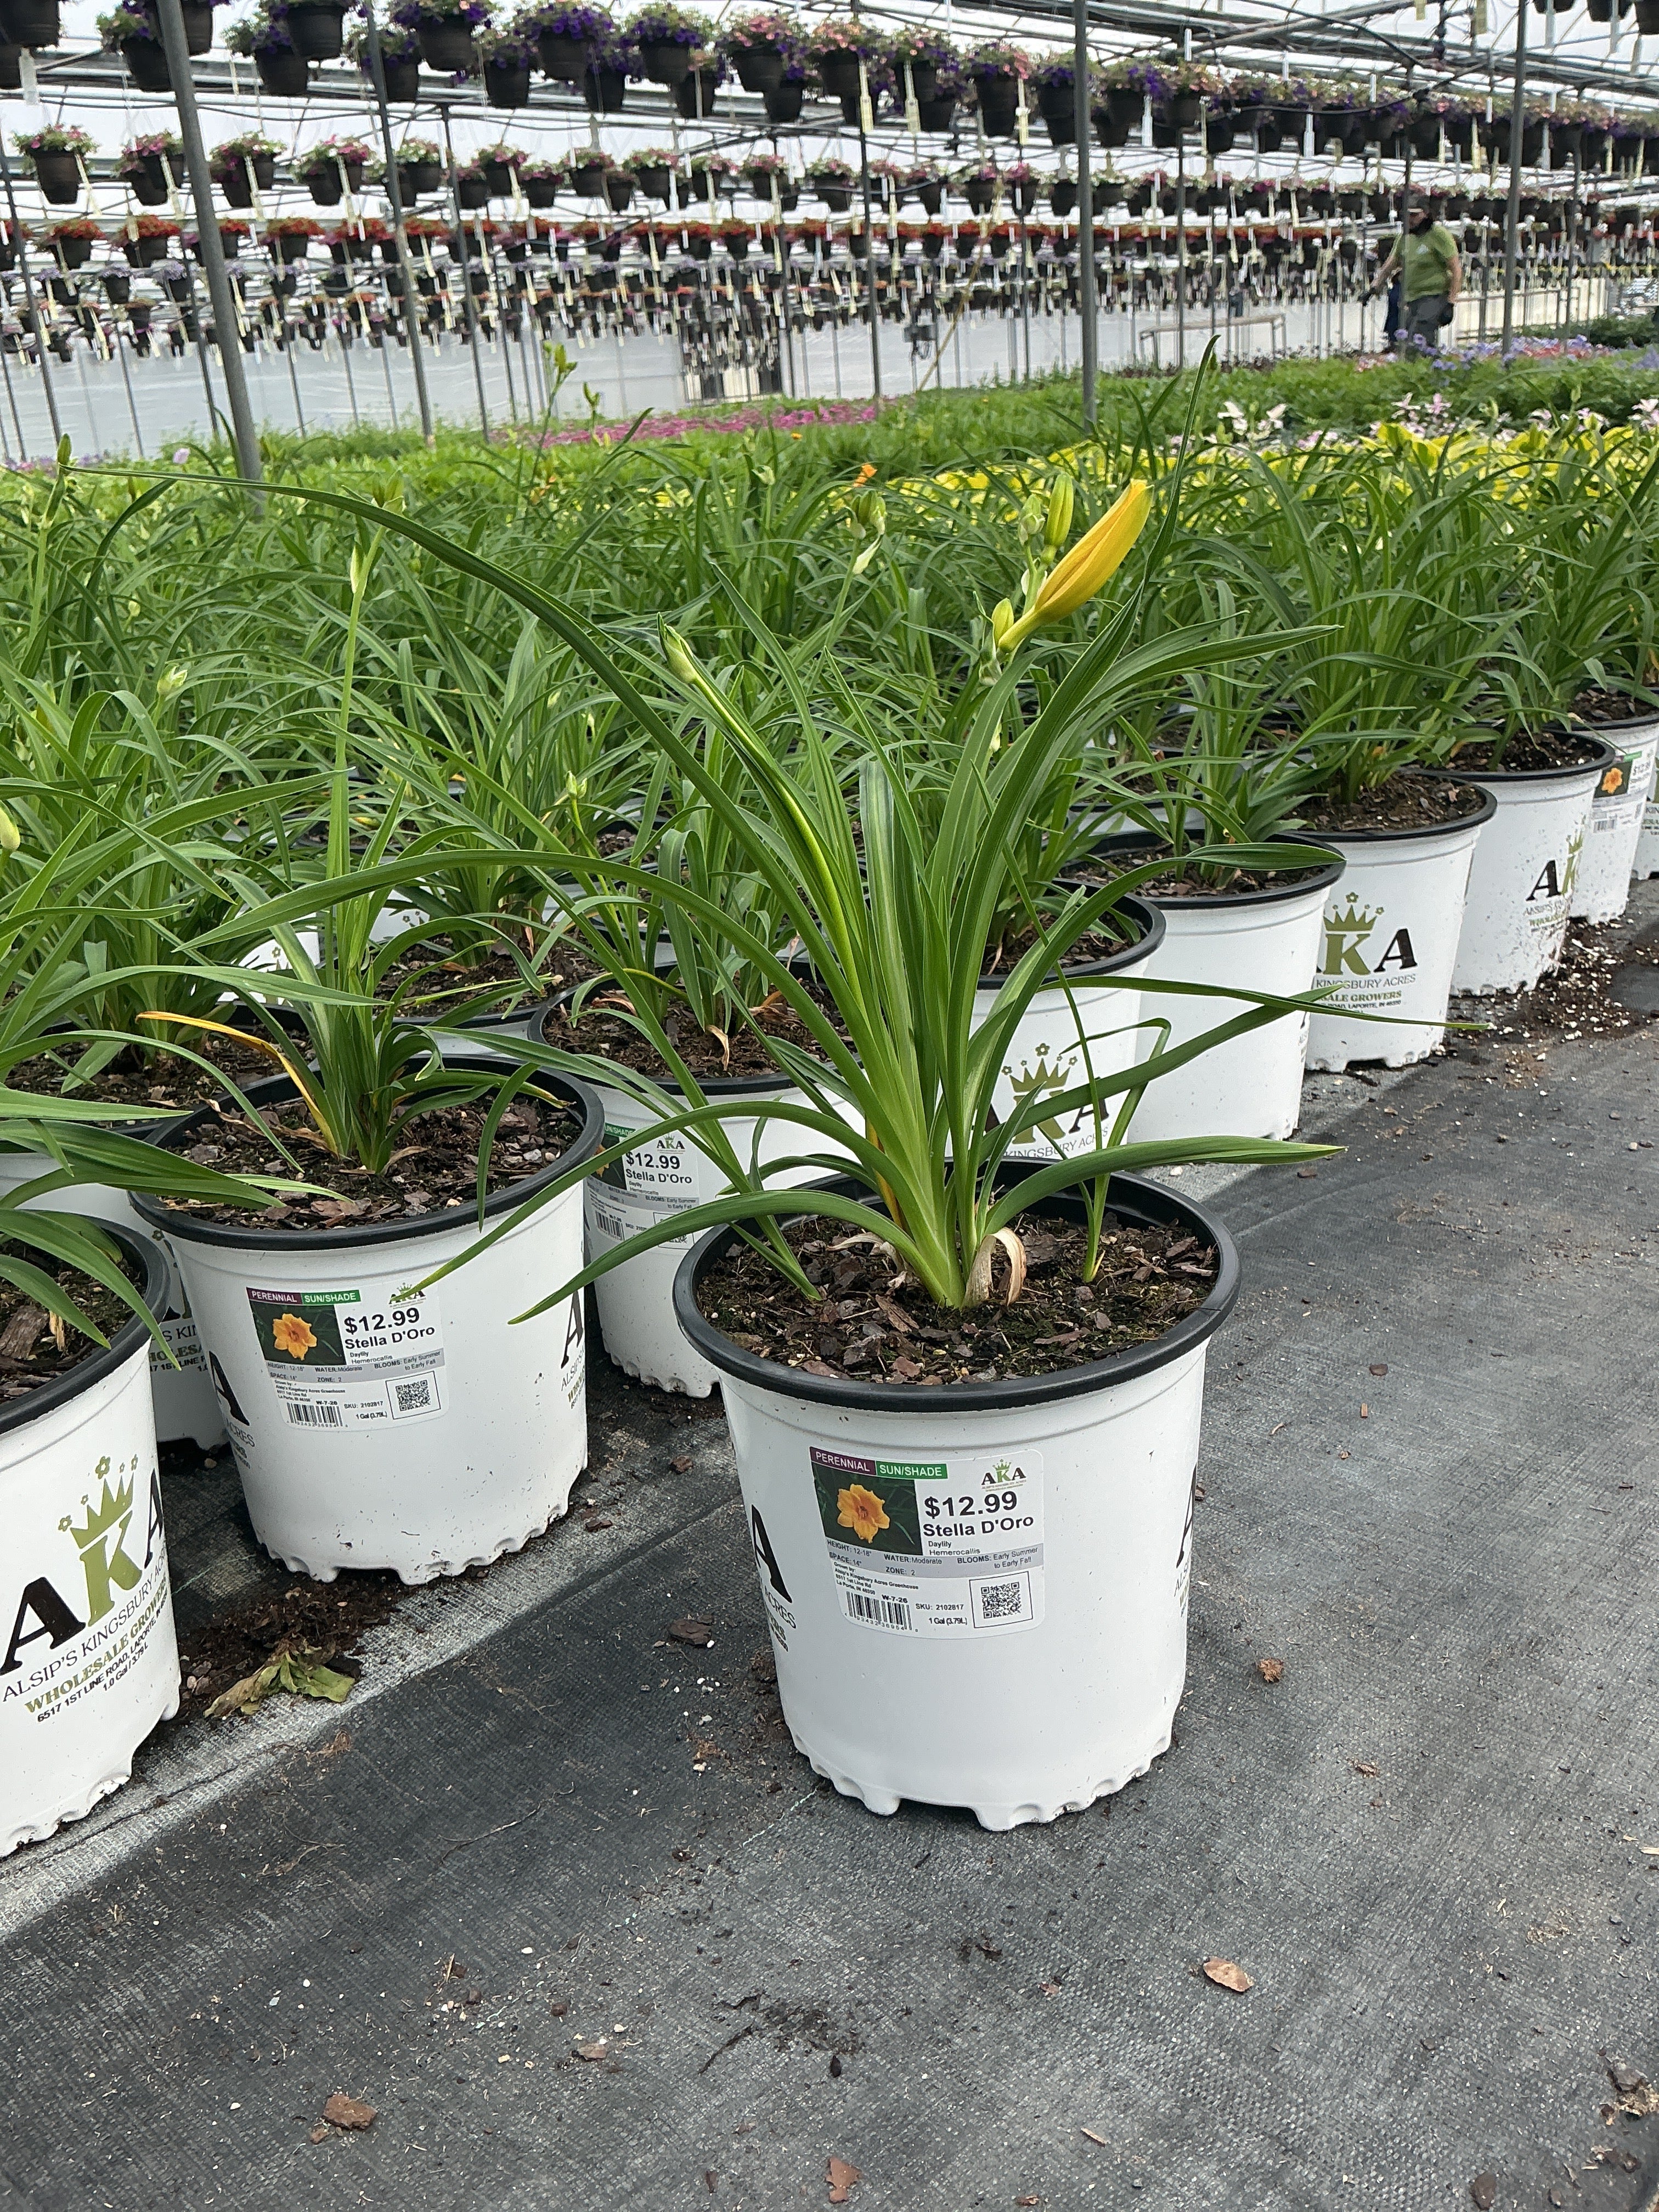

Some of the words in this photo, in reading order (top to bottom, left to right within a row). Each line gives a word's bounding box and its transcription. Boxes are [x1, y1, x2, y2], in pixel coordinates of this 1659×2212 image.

[1317, 928, 1418, 975] KA
[1383, 974, 1416, 987] ACRES
[1350, 990, 1402, 1002] GROWERS
[656, 1139, 686, 1149] AKA
[625, 1152, 681, 1170] $12.99
[625, 1168, 655, 1182] Stella
[658, 1173, 692, 1184] D'Oro
[251, 1290, 298, 1302] PERENNIAL
[304, 1292, 357, 1304] SUN/SHADE
[343, 1307, 420, 1335] $12.99
[345, 1336, 388, 1350] Stella
[391, 1327, 436, 1344] D'Oro
[374, 1360, 403, 1369] BLOOMS:
[418, 1351, 441, 1361] Summer
[411, 1362, 425, 1370] Early
[815, 1451, 871, 1472] PERENNIAL
[879, 1464, 943, 1476] SUN/SHADE
[981, 1467, 1027, 1485] AKA
[924, 1491, 1017, 1519] $12.99
[923, 1523, 975, 1537] Stella
[981, 1516, 1034, 1534] D'Oro
[827, 1539, 852, 1553] HEIGHT:
[928, 1540, 952, 1549] Daylily
[884, 1553, 911, 1563] WATER:
[957, 1555, 992, 1564] BLOOMS:
[993, 1551, 1010, 1560] Early
[1011, 1547, 1038, 1557] Summer
[1002, 1559, 1018, 1568] Early
[1020, 1556, 1032, 1565] Fall
[885, 1566, 907, 1575] ZONE:
[881, 1594, 909, 1604] W-7-26
[3, 1650, 78, 1702] ALSIP'S
[81, 1573, 153, 1657] KINGSBURY
[24, 1633, 129, 1713] WHOLESALE
[103, 1678, 115, 1691] 1.0
[115, 1663, 128, 1681] Gal
[37, 1702, 62, 1723] 6517
[64, 1689, 83, 1707] 1ST
[83, 1673, 105, 1694] LINE
[105, 1651, 130, 1678] ROAD,
